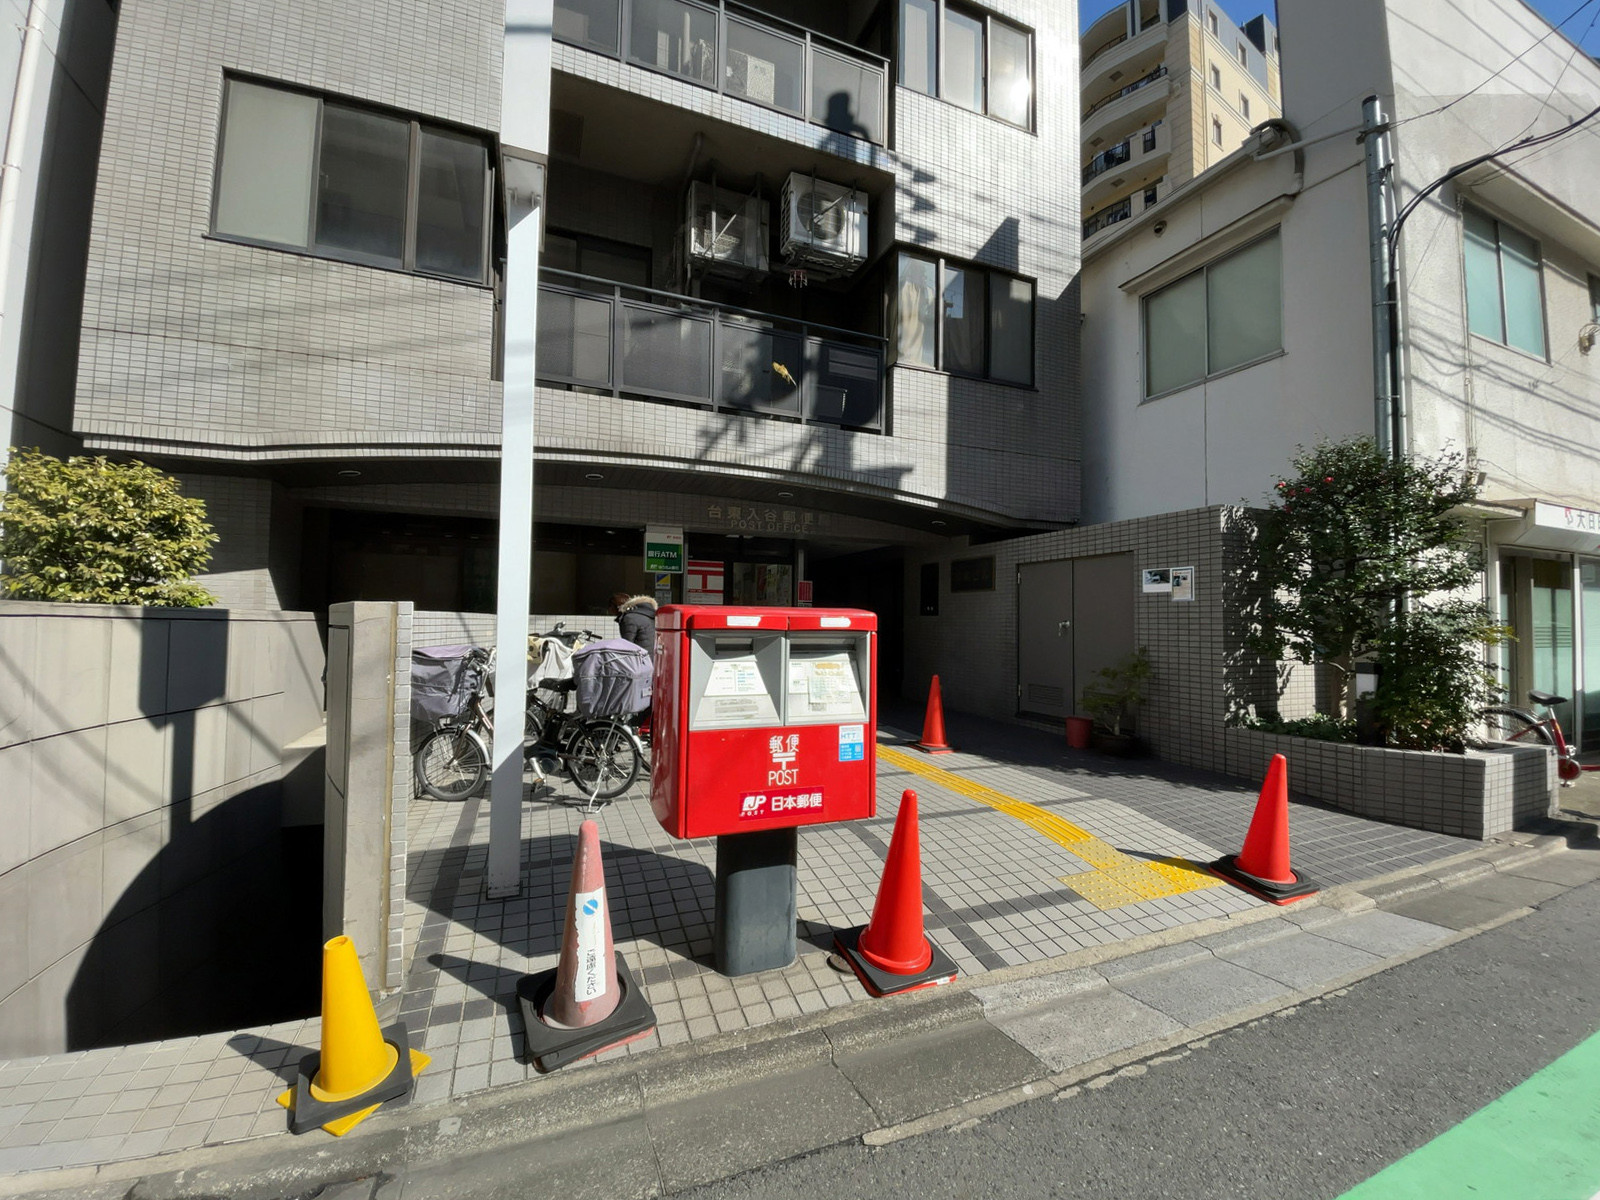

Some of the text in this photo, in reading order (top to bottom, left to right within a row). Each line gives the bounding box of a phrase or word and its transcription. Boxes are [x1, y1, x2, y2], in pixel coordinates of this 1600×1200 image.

[730, 519, 809, 534] POST OFFICE
[1577, 511, 1600, 529] 大日
[647, 550, 678, 559] 銀行ATM
[769, 734, 800, 754] 郵便
[768, 768, 799, 787] POST
[771, 792, 823, 811] 日本郵便
